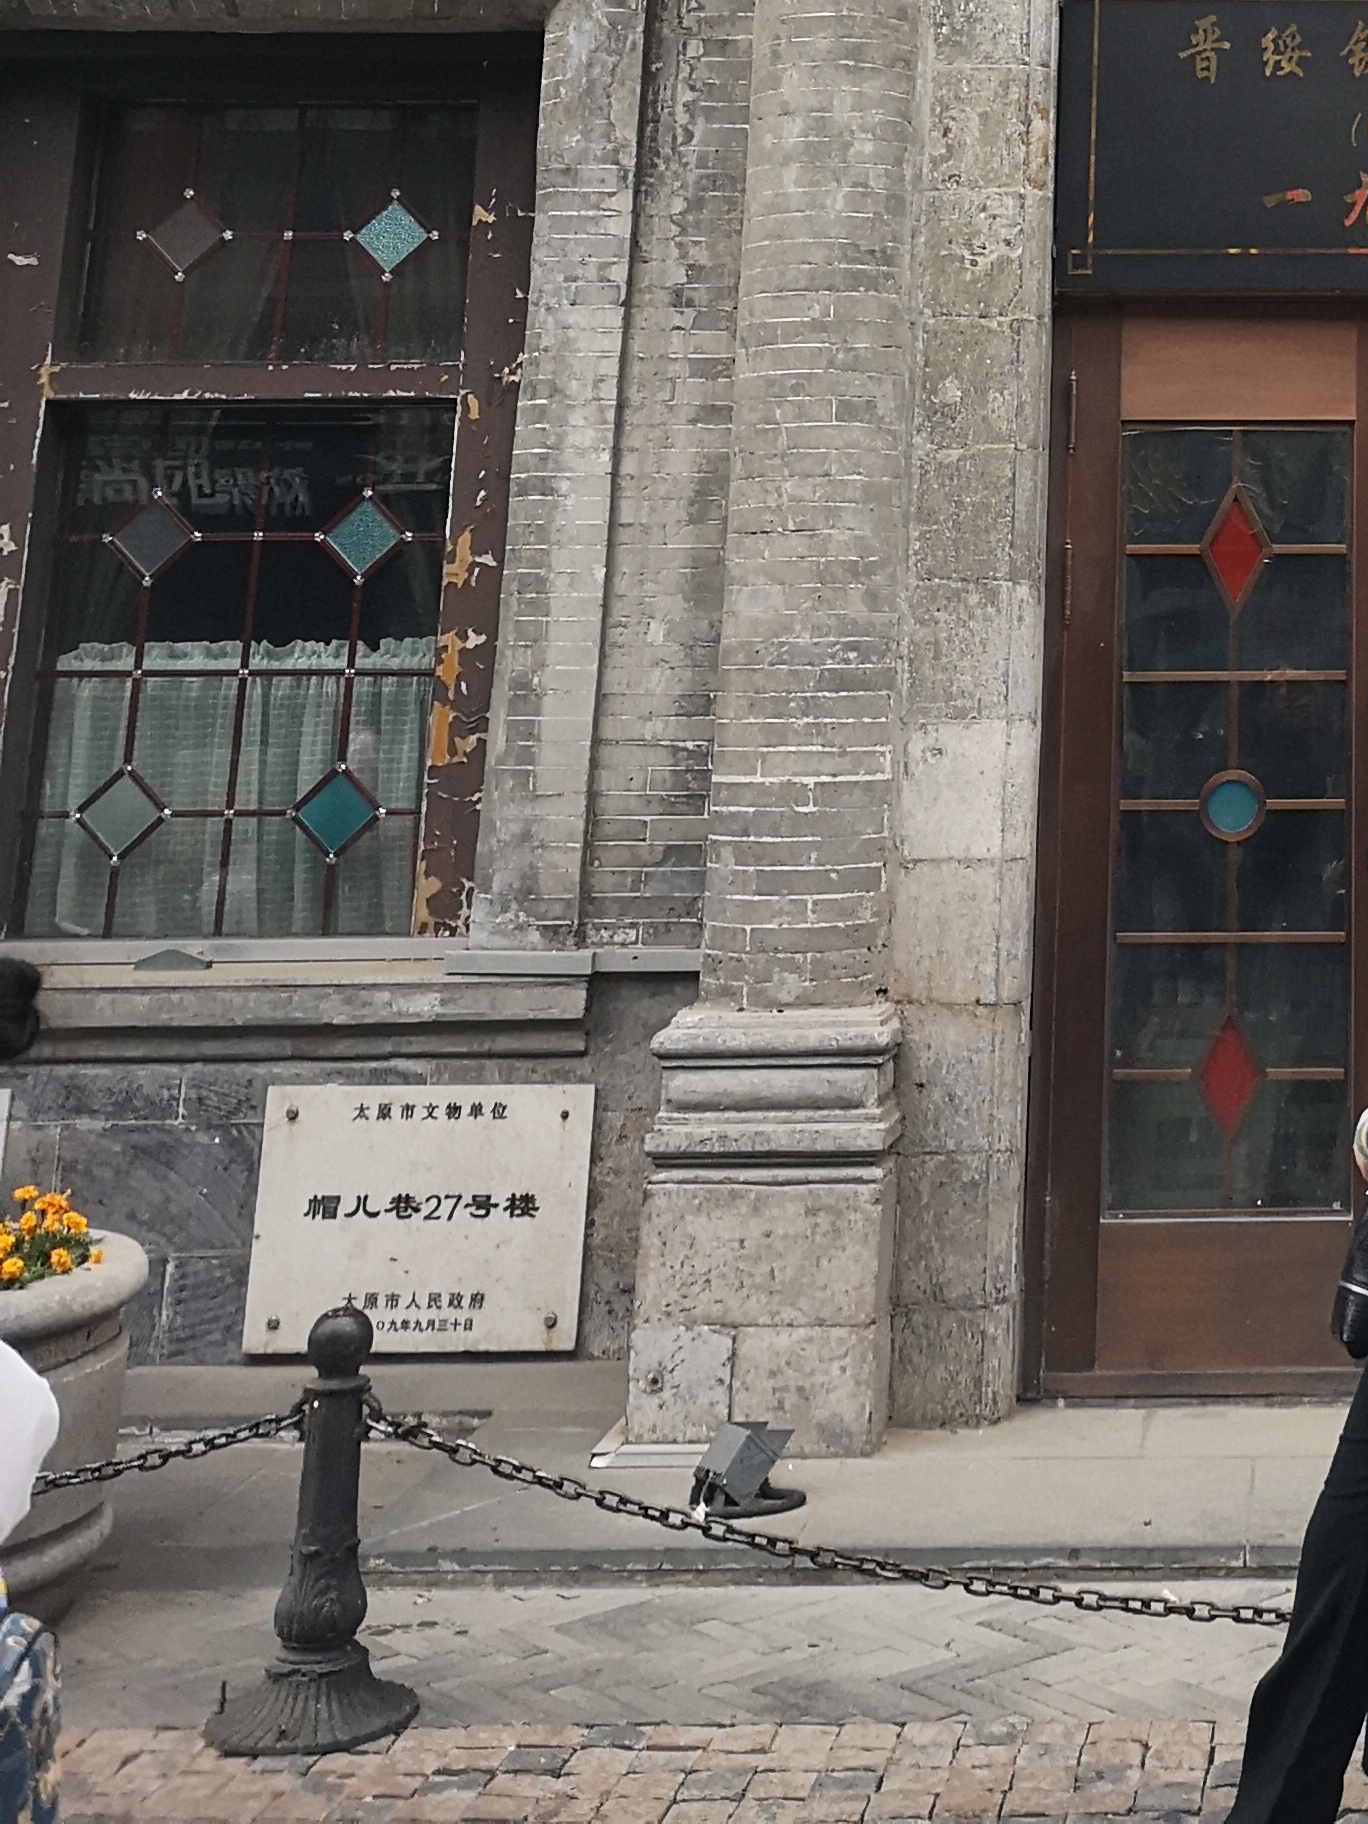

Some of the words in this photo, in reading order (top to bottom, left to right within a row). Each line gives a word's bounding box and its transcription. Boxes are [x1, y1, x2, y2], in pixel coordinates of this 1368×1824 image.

[352, 1102, 509, 1122] 太原市文物单位
[303, 1192, 540, 1222] 帽儿巷27号楼
[342, 1291, 486, 1311] 太原市人民政府
